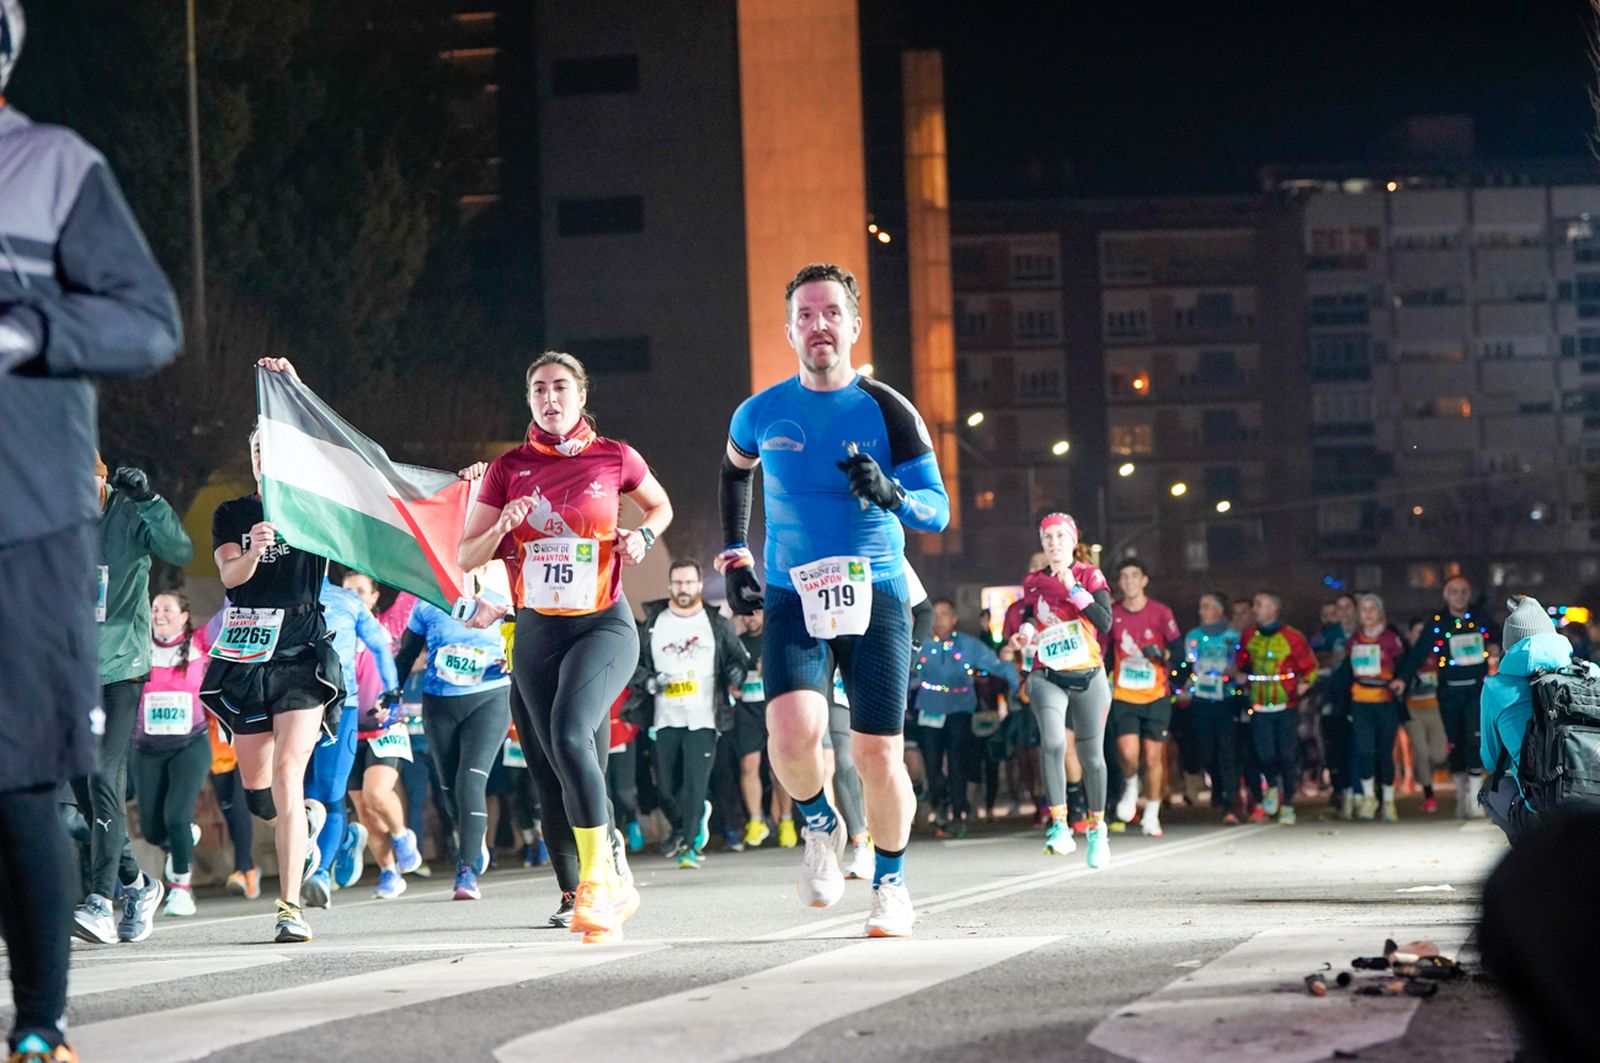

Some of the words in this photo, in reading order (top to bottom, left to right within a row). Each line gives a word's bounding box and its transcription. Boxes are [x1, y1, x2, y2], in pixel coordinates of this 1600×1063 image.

[543, 518, 564, 535] 43
[543, 563, 574, 584] 715
[817, 584, 855, 611] 719
[226, 626, 271, 645] 12265
[446, 655, 477, 673] 8524
